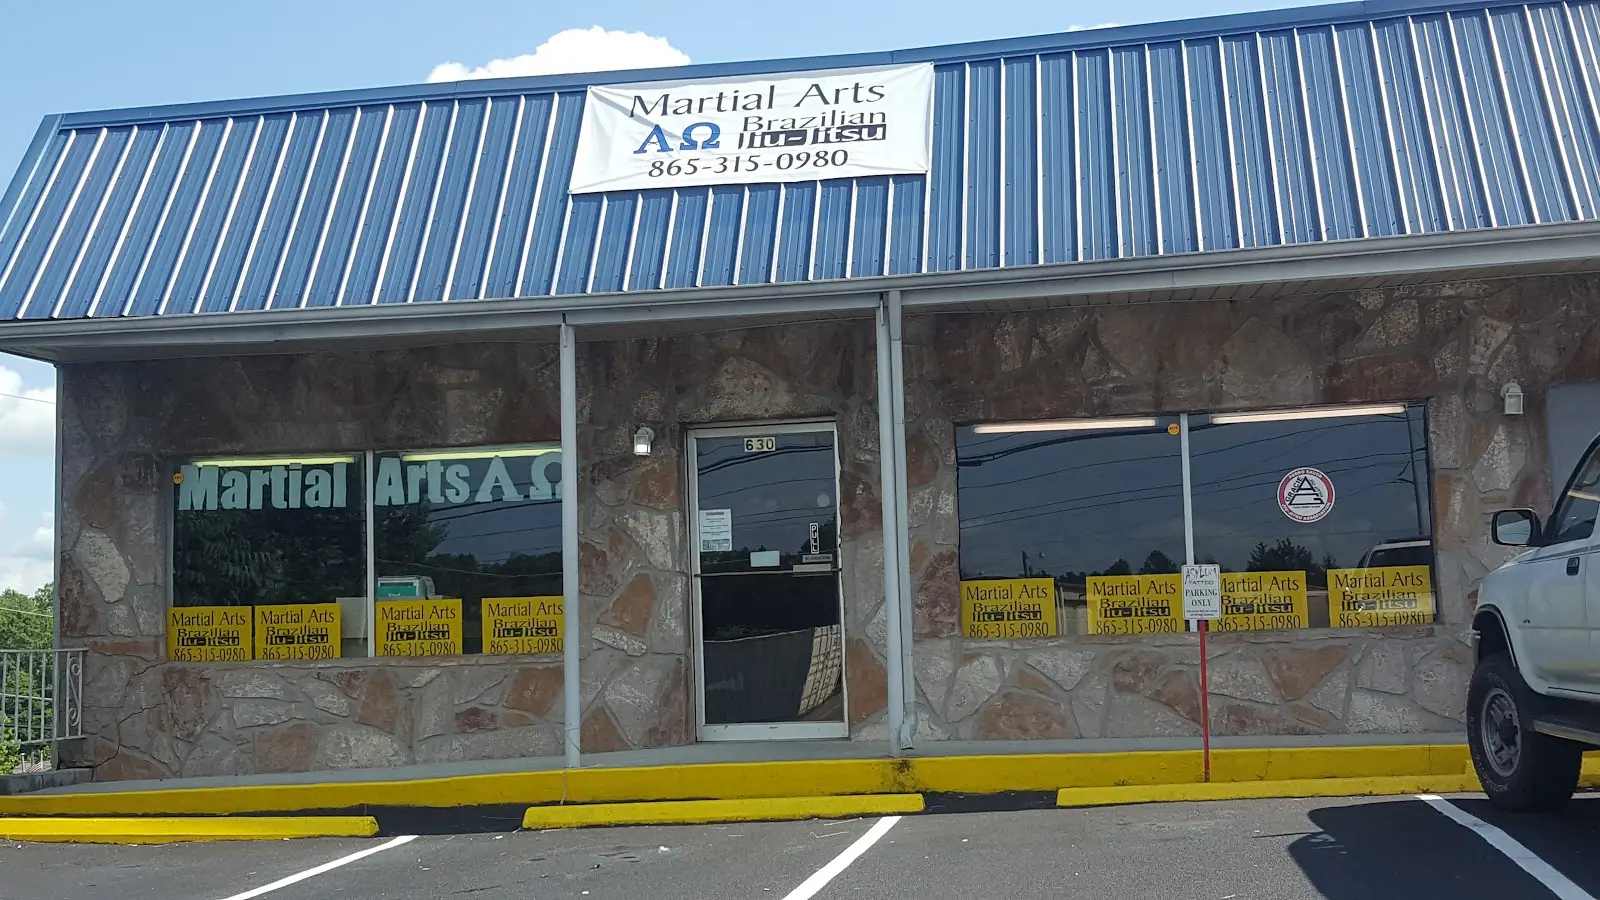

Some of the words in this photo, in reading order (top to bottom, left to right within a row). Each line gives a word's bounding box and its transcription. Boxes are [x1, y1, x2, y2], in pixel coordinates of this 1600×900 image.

[629, 84, 775, 118] Martial
[794, 82, 885, 108] Arts
[743, 109, 886, 132] Brazilian
[738, 124, 887, 150] Jiu-Jitsu
[648, 149, 849, 178] 865-315-0980
[745, 439, 775, 451] 630
[179, 462, 347, 510] Martial
[375, 457, 471, 506] Arts
[1285, 475, 1304, 502] GRACIE
[811, 524, 819, 552] PULL
[1269, 576, 1299, 591] Arts
[1335, 571, 1385, 588] Martial
[1391, 571, 1424, 587] Arts
[966, 584, 1013, 600] Martial
[1018, 584, 1048, 599] Arts
[1093, 580, 1140, 596] Martial
[1147, 580, 1176, 595] Arts
[1185, 588, 1218, 597] PARKING
[1342, 589, 1416, 601] Brazilian
[973, 601, 1041, 612] Brazilian
[1100, 597, 1169, 609] Brazilian
[1191, 599, 1212, 607] ONLY
[1221, 594, 1292, 605] Brazilian
[261, 609, 303, 625] Martial
[308, 609, 335, 623] Arts
[381, 604, 424, 621] Martial
[429, 605, 456, 620] Arts
[488, 601, 531, 617] Martial
[536, 601, 563, 616] Arts
[172, 611, 214, 627] Martial
[219, 611, 246, 626] Arts
[387, 621, 450, 632] Brazilian
[494, 618, 557, 628] Brazilian
[1096, 618, 1178, 635] 865-315-0980
[1217, 615, 1301, 632] 865-315-0980
[1339, 611, 1425, 628] 865-315-0980
[177, 626, 240, 638] Brazilian
[266, 625, 328, 636] Brazilian
[969, 622, 1049, 638] 865-315-0980
[262, 645, 334, 660] 865-315-0980
[383, 641, 456, 656] 865-315-0980
[490, 638, 564, 653] 865-315-0980
[173, 647, 246, 661] 865-315-0980
